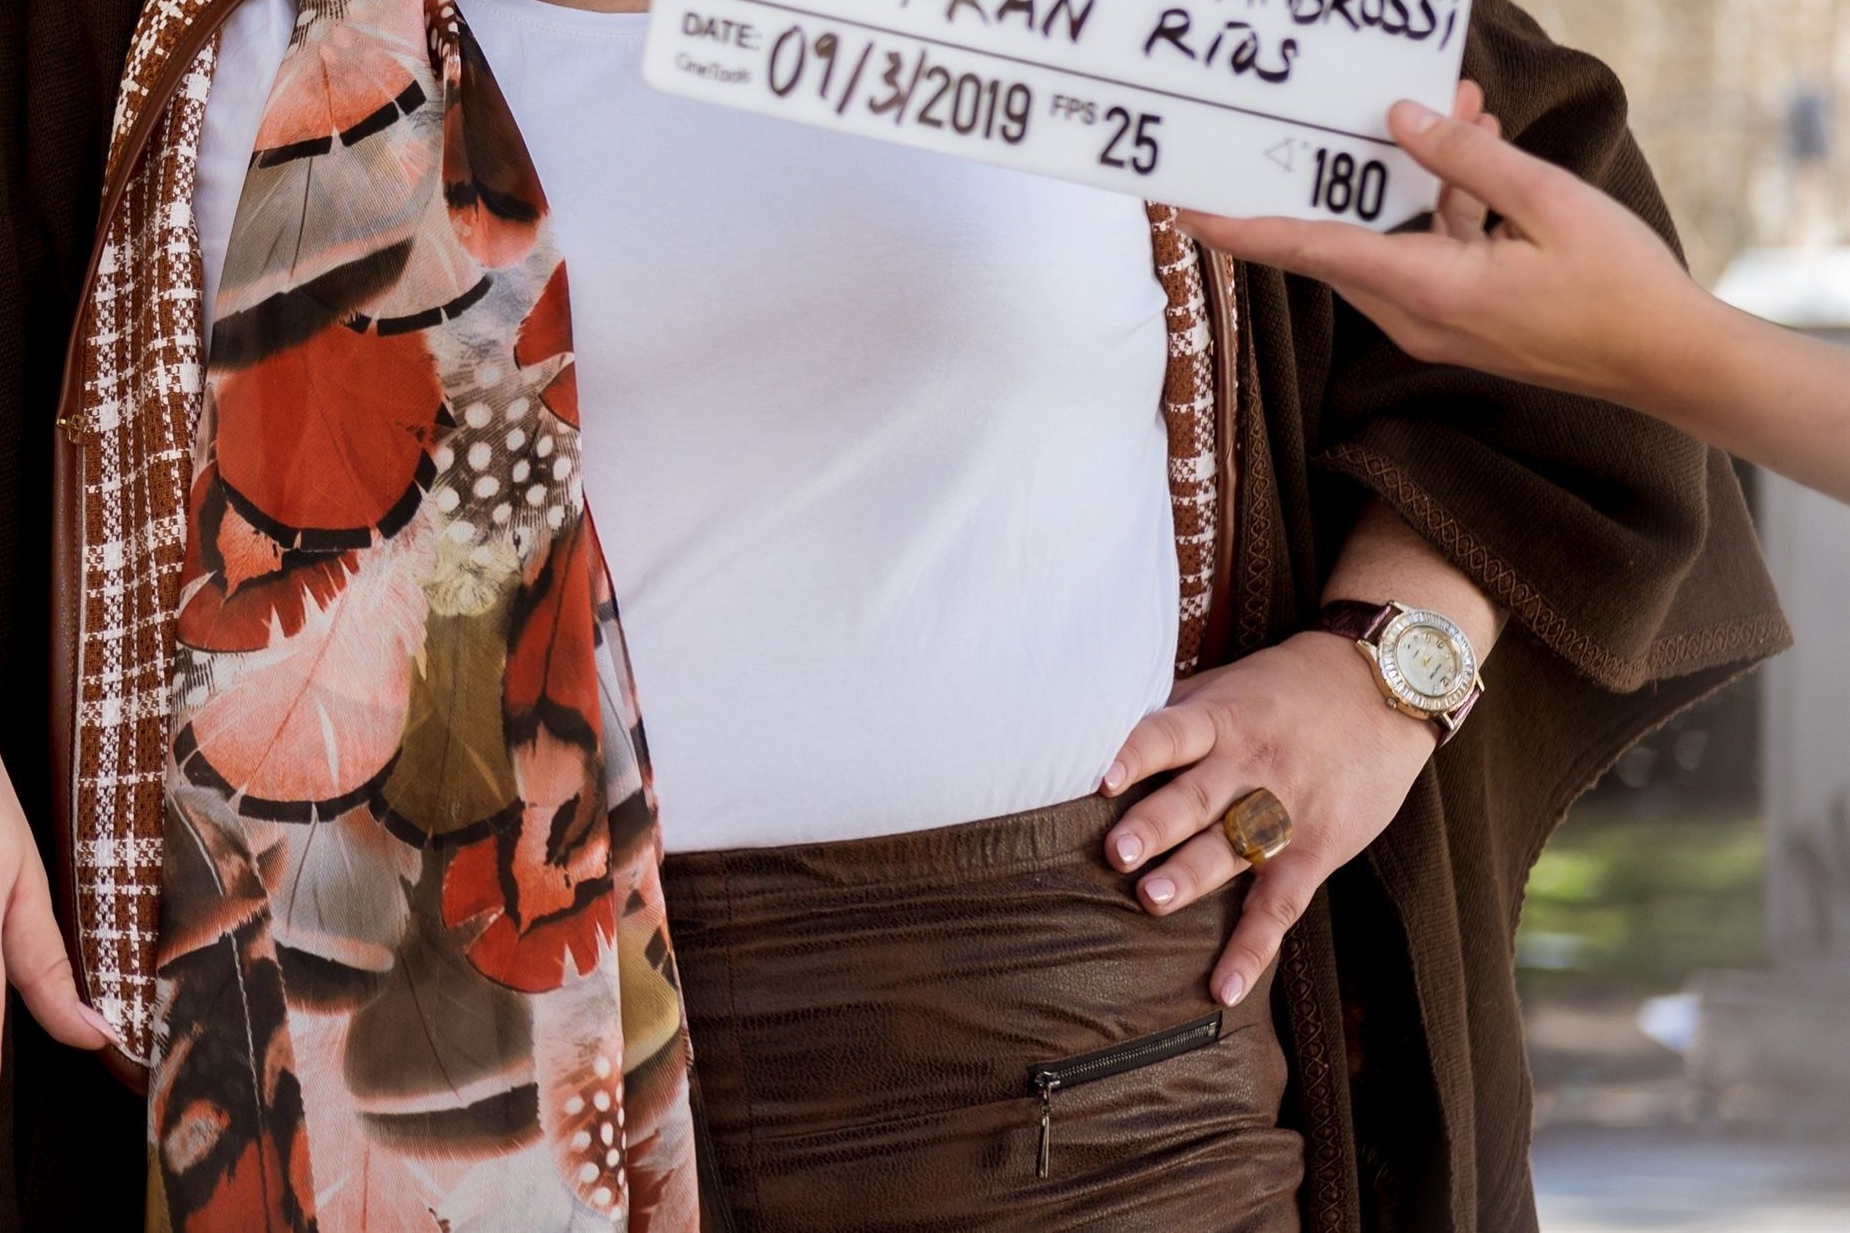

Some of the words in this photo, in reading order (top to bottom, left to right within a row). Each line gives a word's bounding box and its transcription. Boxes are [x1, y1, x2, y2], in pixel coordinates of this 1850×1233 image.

[1050, 92, 1099, 126] FPS
[1098, 105, 1165, 177] 25
[1310, 146, 1389, 222] 180
